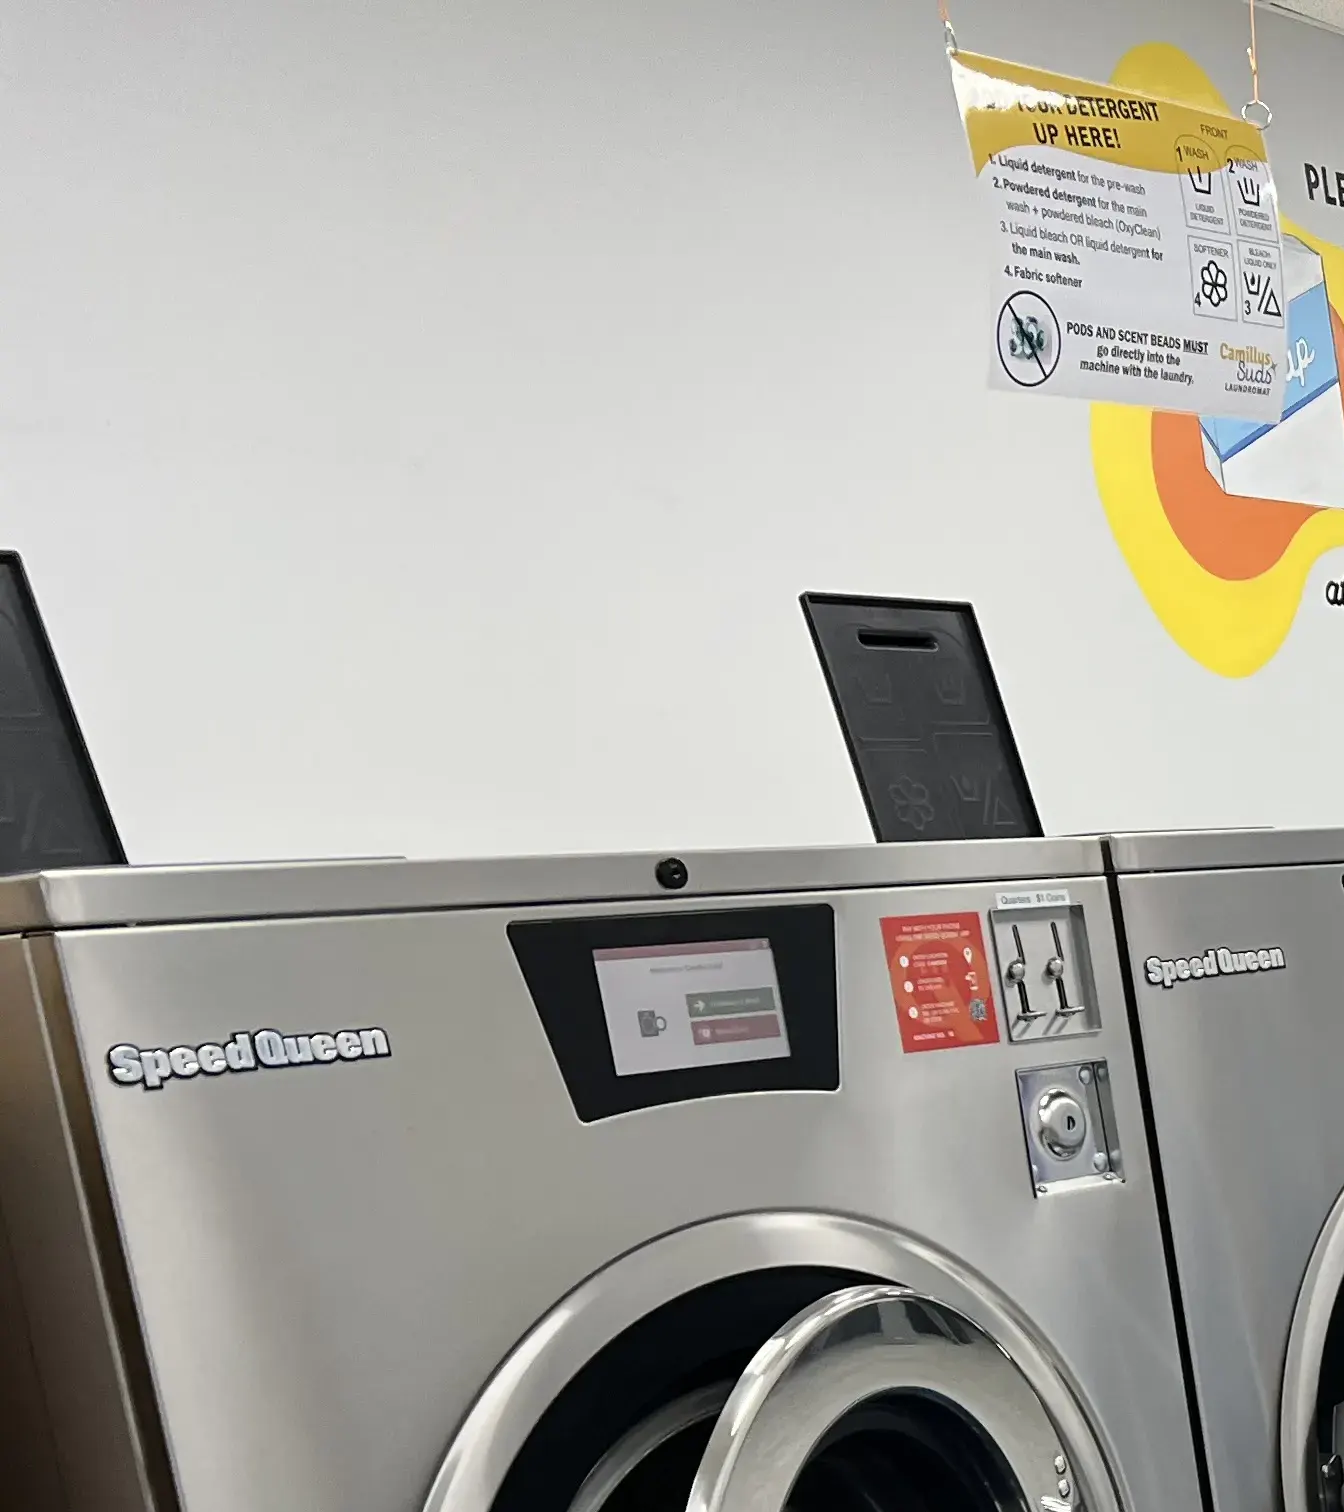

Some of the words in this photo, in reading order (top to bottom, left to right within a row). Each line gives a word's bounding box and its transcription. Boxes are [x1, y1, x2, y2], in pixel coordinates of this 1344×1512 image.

[1033, 122, 1058, 144] UP
[1064, 124, 1121, 148] HERE!
[1200, 124, 1228, 139] FRONT
[1176, 146, 1183, 162] 1
[1183, 145, 1209, 160] WASH
[1227, 158, 1235, 173] 2
[1235, 157, 1258, 172] WASH
[998, 154, 1029, 172] Liquid
[1031, 161, 1075, 182] detergent
[1077, 171, 1089, 183] for
[1090, 174, 1104, 187] the
[1106, 178, 1145, 196] pre-wash
[993, 177, 1002, 189] 2.
[1003, 178, 1050, 199] Powdered
[1053, 188, 1096, 207] detergent
[1111, 201, 1125, 213] the
[1127, 205, 1147, 218] main
[1006, 200, 1030, 213] wash
[1032, 207, 1038, 215] +
[1041, 207, 1084, 224] powdered
[1086, 215, 1114, 230] bleach
[1115, 220, 1161, 241] (OxyClean)
[1000, 221, 1009, 232] 3.
[1010, 223, 1037, 238] Liquid
[1039, 227, 1068, 244] bleach
[1070, 233, 1084, 247] OR
[1085, 236, 1108, 252] liquid
[1110, 241, 1149, 260] detergent
[1151, 249, 1164, 262] for
[1012, 242, 1027, 256] the
[1029, 247, 1052, 261] main
[1054, 251, 1080, 265] wash.
[1004, 265, 1013, 277] 4.
[1014, 266, 1043, 282] Fabric
[1045, 272, 1082, 288] softener
[1195, 292, 1201, 307] 4
[1244, 300, 1251, 315] 3
[1066, 322, 1093, 338] PODS
[1096, 325, 1116, 341] AND
[1118, 329, 1148, 346] SCENT
[1150, 334, 1181, 350] BEADS
[1183, 339, 1208, 353] MUST
[1097, 344, 1109, 359] go
[1110, 346, 1144, 364] directly
[1147, 351, 1164, 364] into
[1166, 353, 1180, 366] the
[1220, 343, 1271, 366] Camillys
[1080, 360, 1120, 375] machine
[1122, 365, 1142, 378] with
[1143, 366, 1159, 380] the
[1160, 369, 1194, 385] laundry.
[1237, 361, 1272, 385] Suds
[1224, 382, 1270, 396] LAUNDROMAT
[1001, 896, 1031, 905] Quarters
[1046, 893, 1066, 902] Coins
[1144, 948, 1219, 990] Speed
[1216, 946, 1287, 978] Queen
[106, 1030, 260, 1090] Speed
[254, 1026, 392, 1068] Queen
